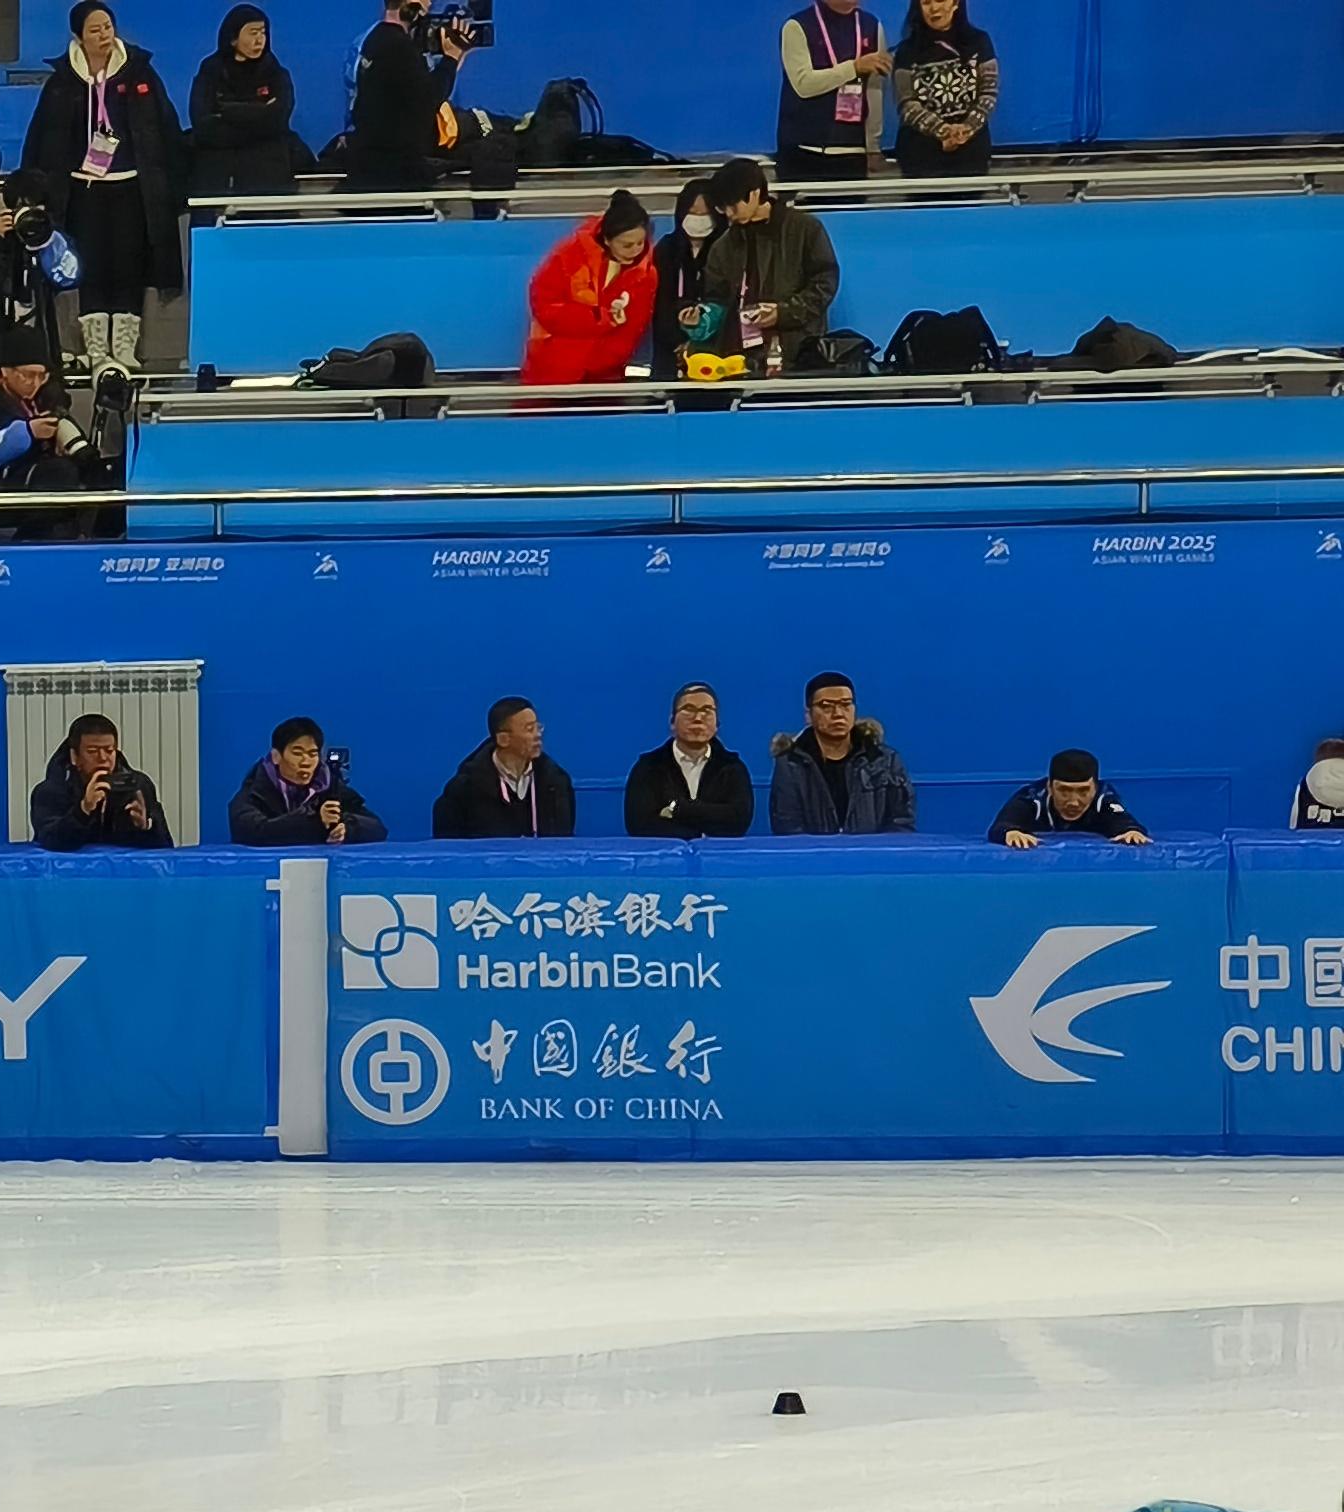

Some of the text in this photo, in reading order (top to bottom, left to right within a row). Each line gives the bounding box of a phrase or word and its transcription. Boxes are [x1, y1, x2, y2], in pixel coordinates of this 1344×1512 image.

[1092, 535, 1216, 552] HARBIN 2025
[431, 549, 550, 566] HARBIN 2025
[458, 952, 722, 989] HarbinBank
[480, 1097, 723, 1120] BANK OF CHINA
